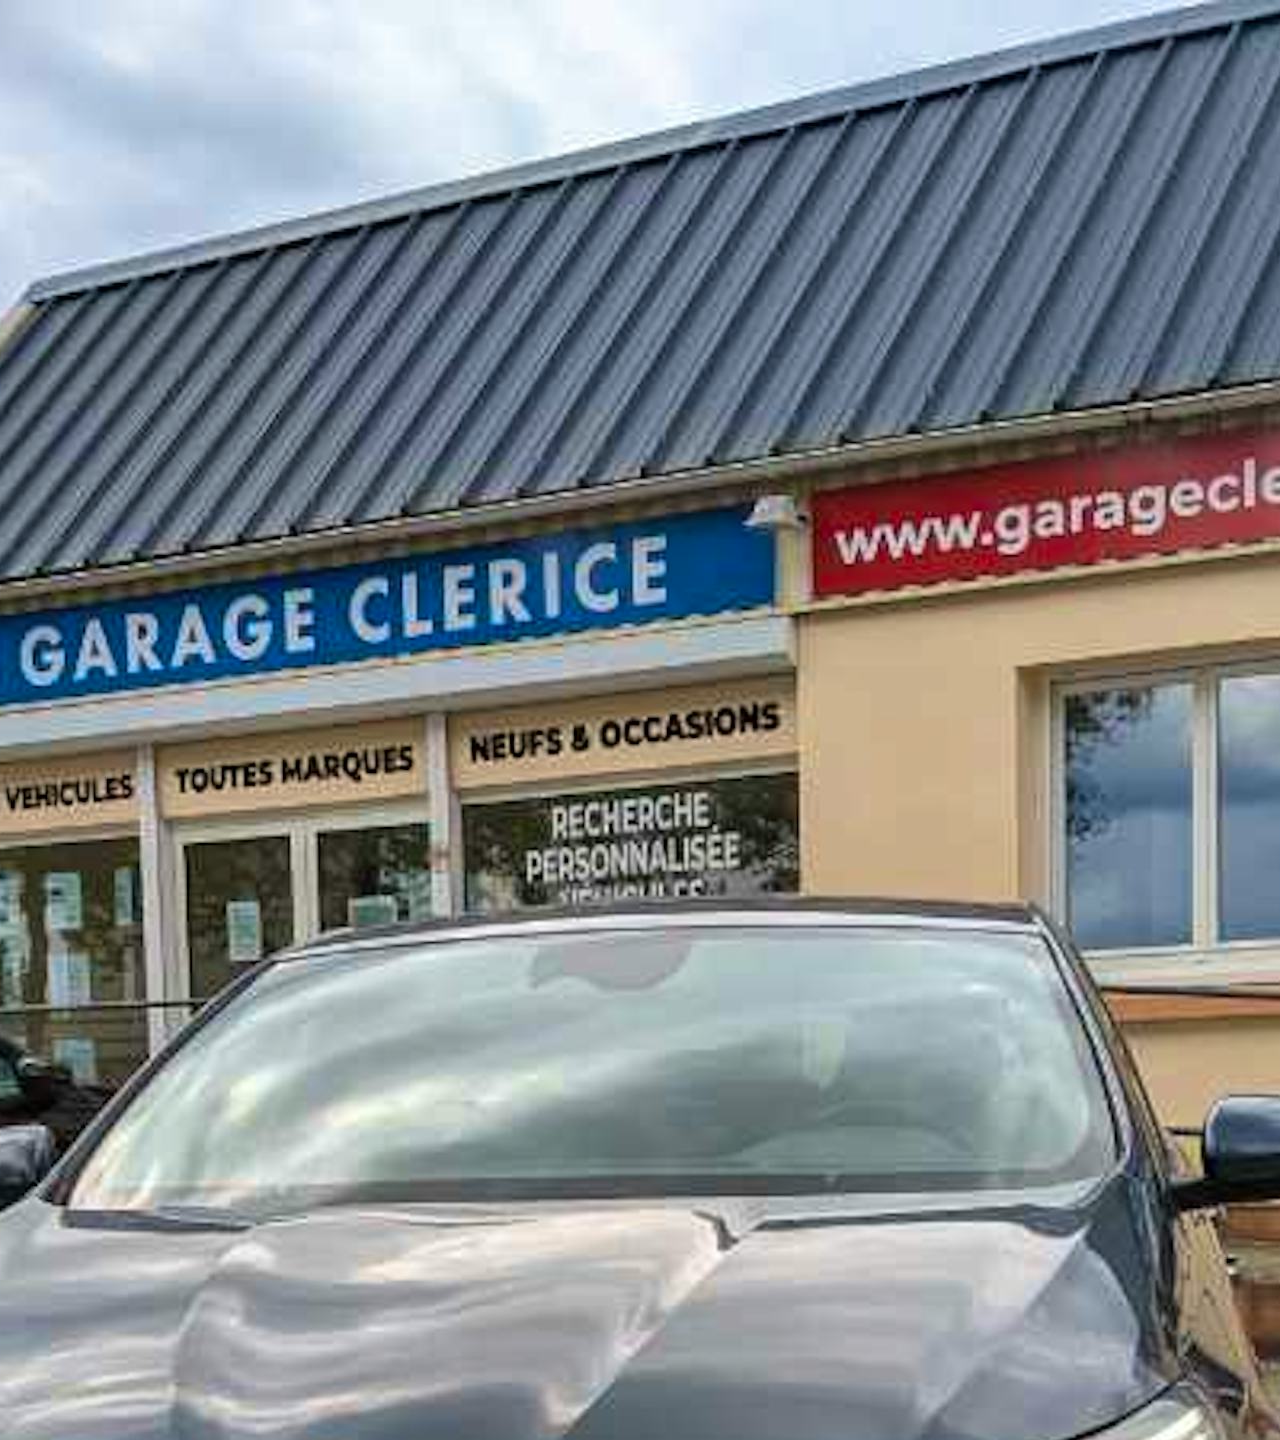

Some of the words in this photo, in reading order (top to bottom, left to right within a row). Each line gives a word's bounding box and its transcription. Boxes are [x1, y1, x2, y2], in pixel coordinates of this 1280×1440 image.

[21, 587, 316, 686] GARAGE
[349, 534, 667, 643] CLERICE
[470, 726, 561, 764] NEUFS
[571, 725, 590, 752] &
[601, 703, 779, 747] OCCASIONS
[5, 774, 133, 811] VEHICULES
[176, 757, 273, 793] TOUTES
[281, 745, 413, 782] MARQUES
[552, 792, 710, 839] RECHERCHE
[526, 825, 741, 883] PERSONNALISÉE
